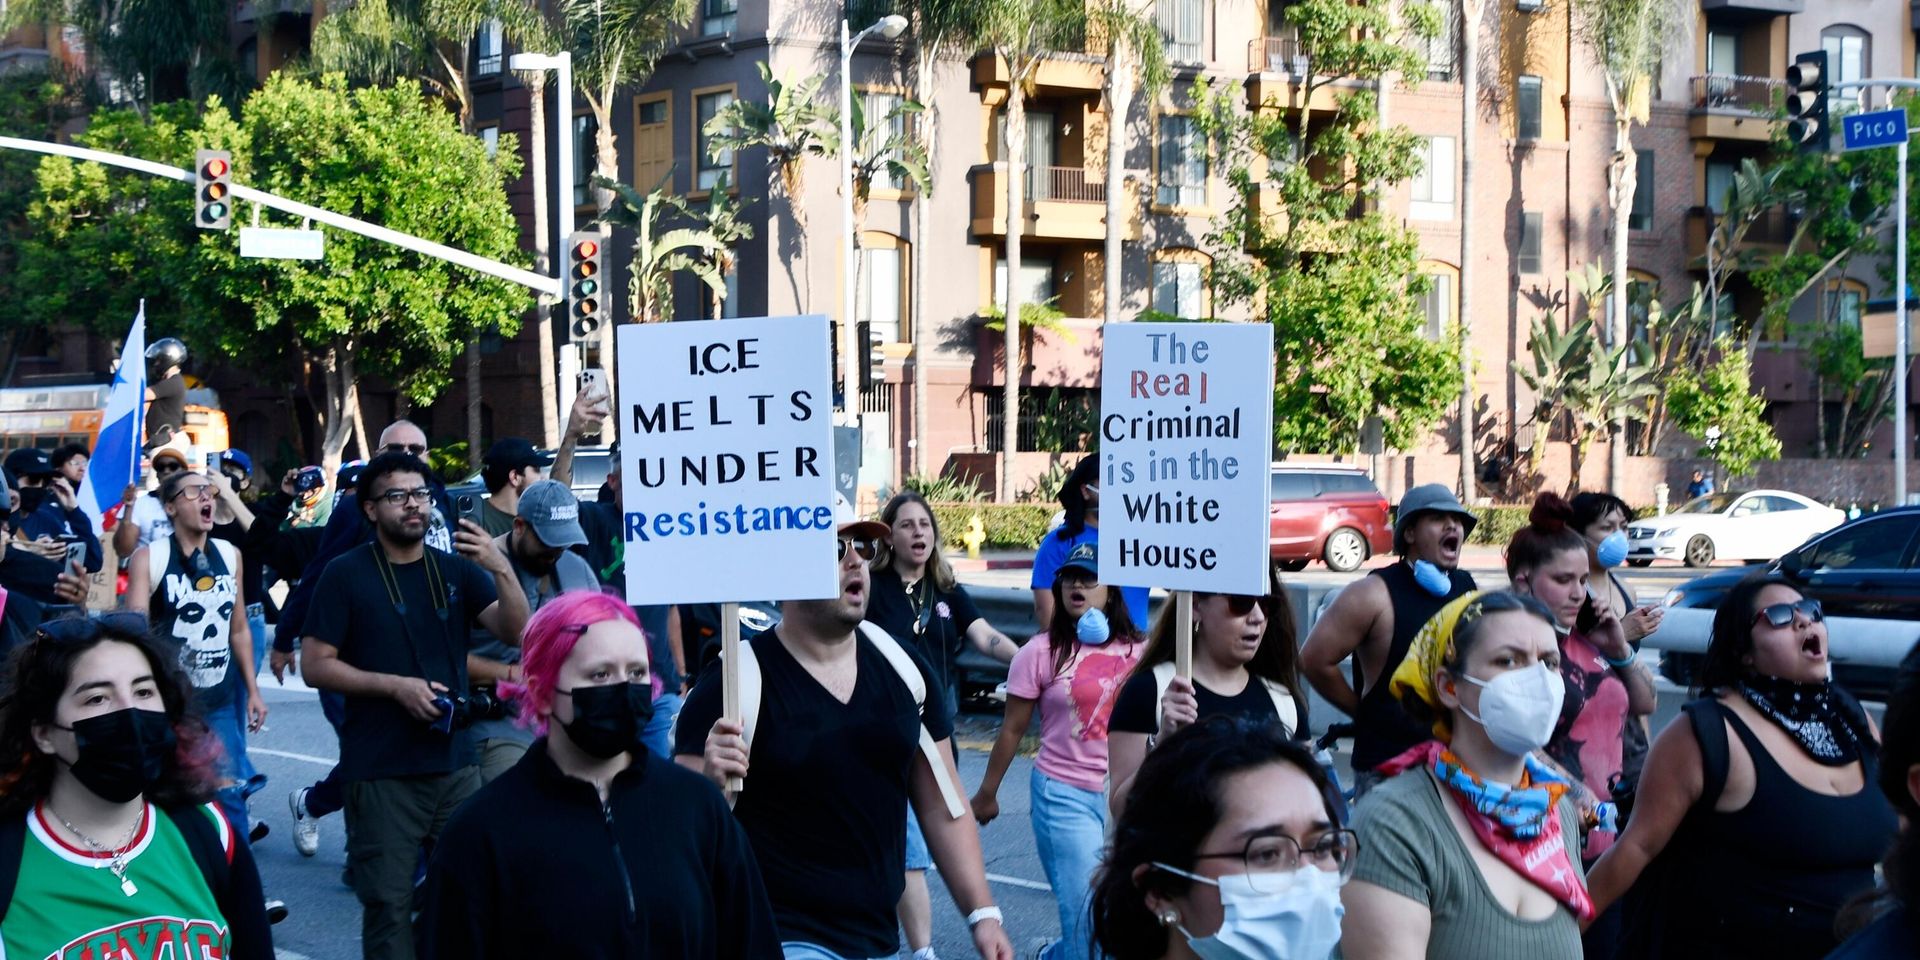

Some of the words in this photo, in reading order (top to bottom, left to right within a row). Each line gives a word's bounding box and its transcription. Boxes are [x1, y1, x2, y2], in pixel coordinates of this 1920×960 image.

[689, 338, 759, 376] I.C.E
[1146, 332, 1209, 364] The
[1130, 370, 1207, 404] Real
[633, 390, 812, 434] MELTS
[1103, 405, 1240, 442] Criminal
[638, 446, 820, 488] UNDER
[1107, 454, 1134, 486] is
[1149, 450, 1178, 482] in
[1188, 448, 1239, 480] the
[624, 501, 832, 542] Resistance
[1122, 491, 1220, 524] White
[1119, 538, 1217, 571] House
